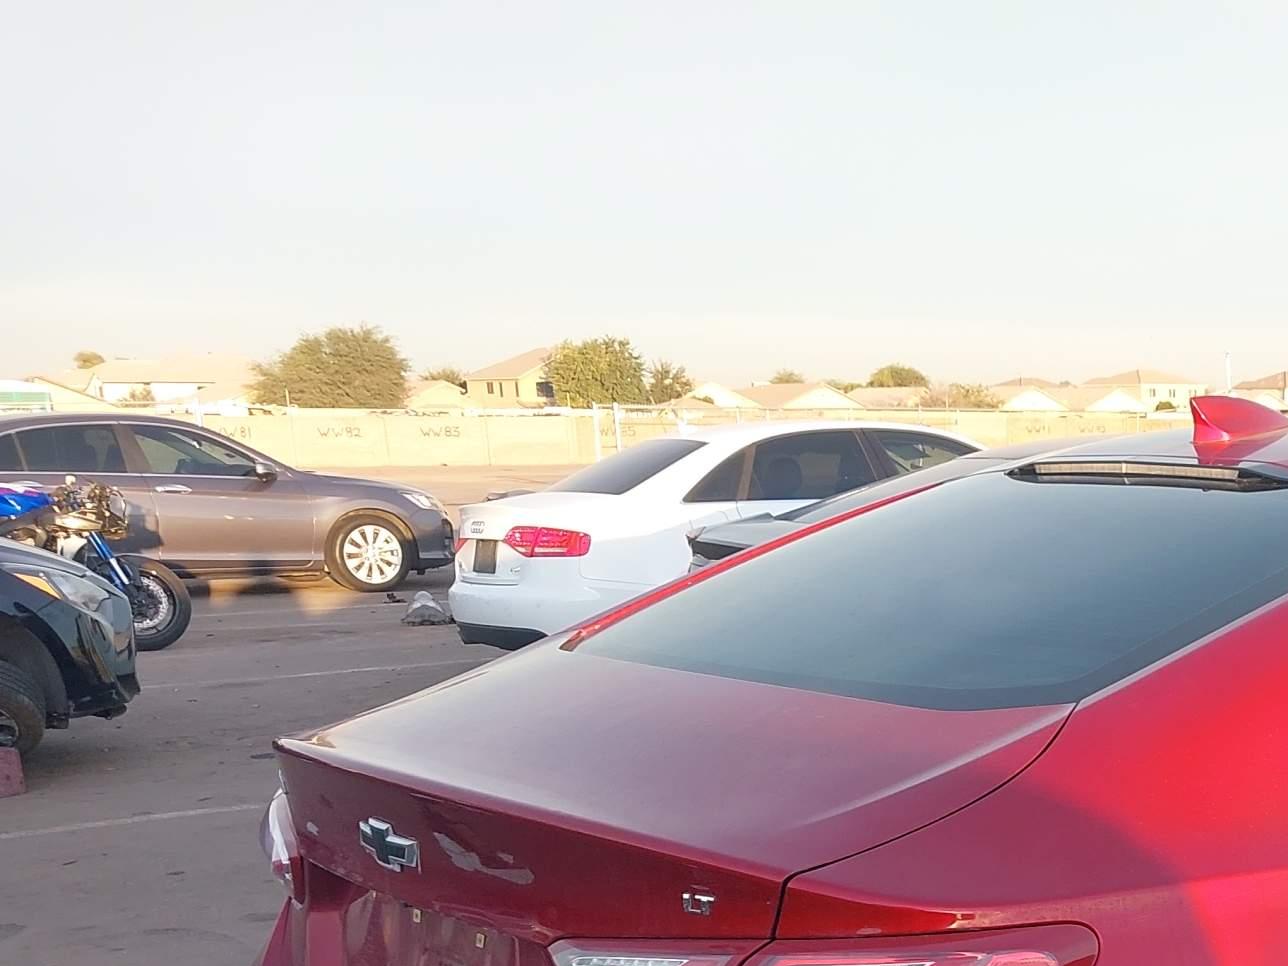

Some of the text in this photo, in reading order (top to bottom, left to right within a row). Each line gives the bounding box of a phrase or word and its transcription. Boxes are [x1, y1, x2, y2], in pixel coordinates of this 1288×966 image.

[316, 425, 363, 438] WW82
[419, 425, 461, 438] WW83
[682, 892, 715, 915] LT
